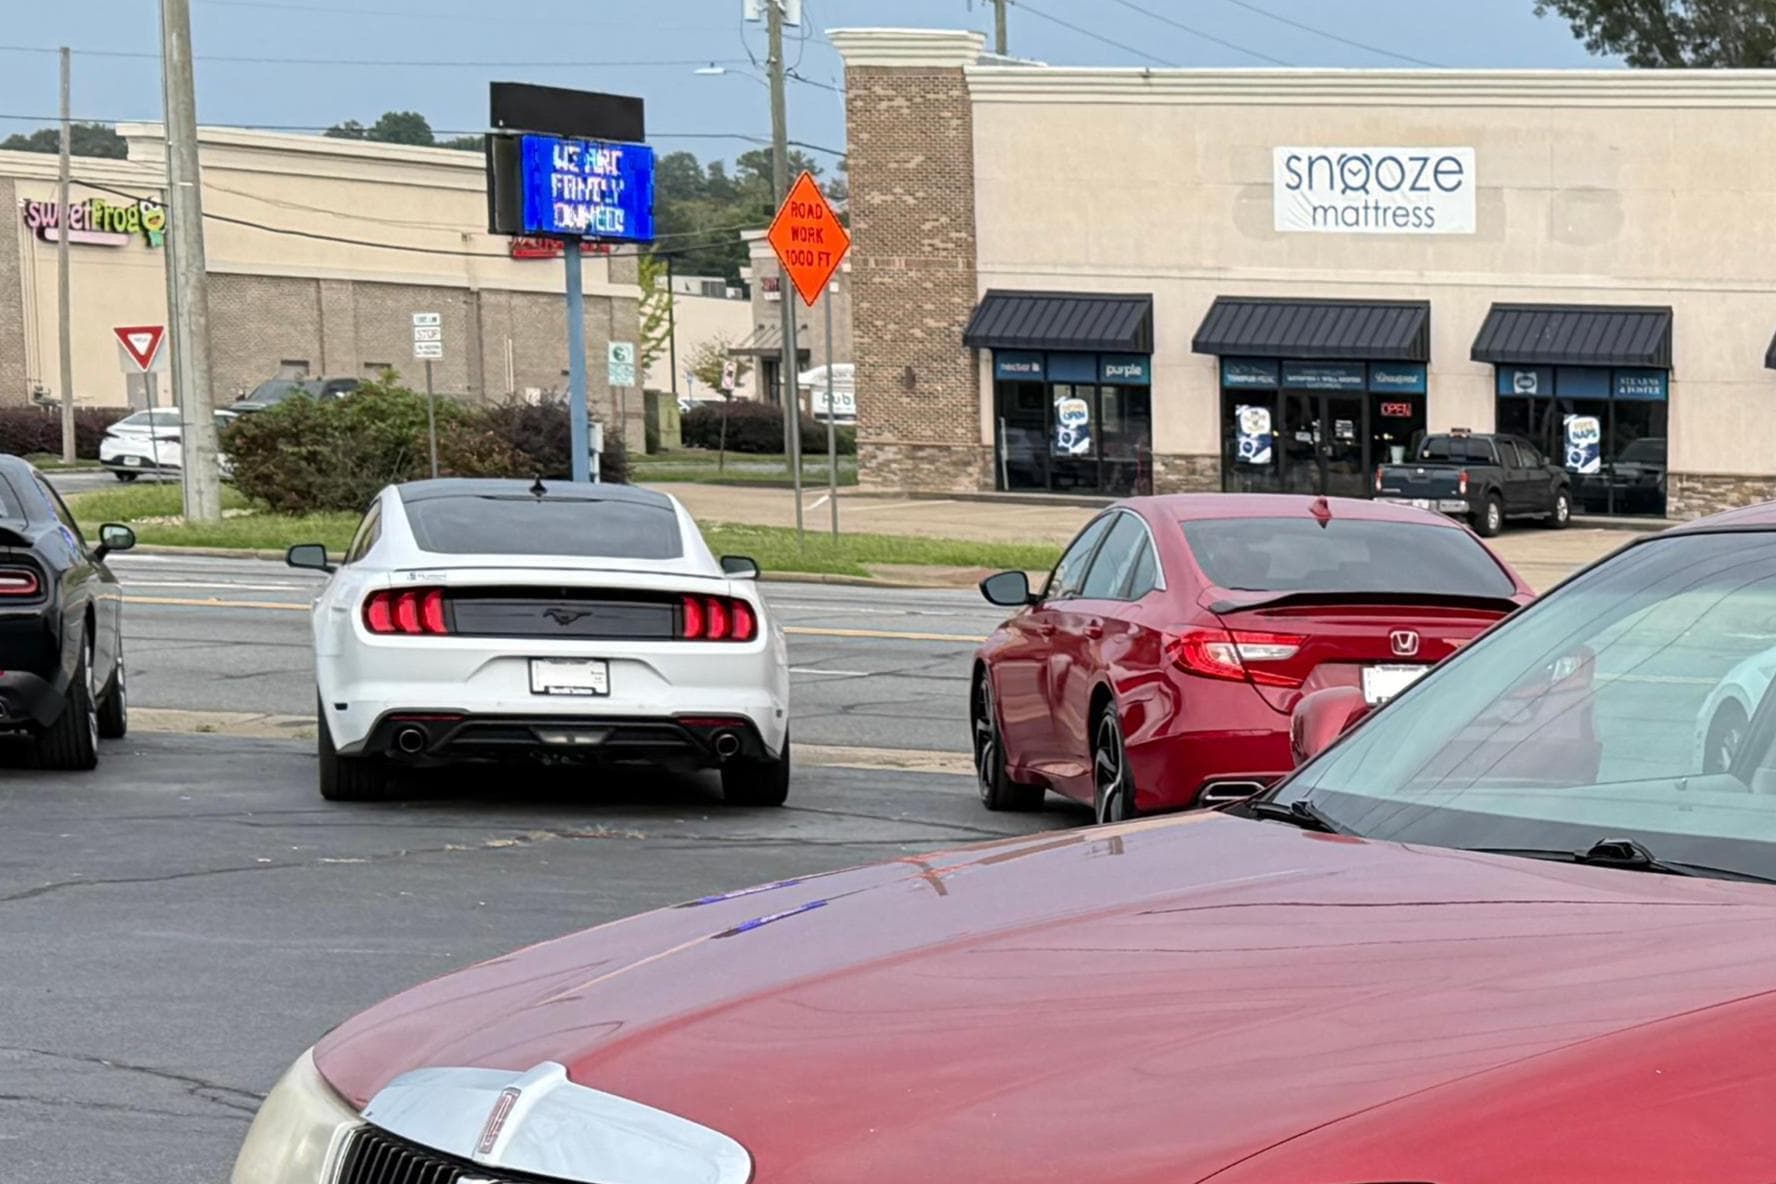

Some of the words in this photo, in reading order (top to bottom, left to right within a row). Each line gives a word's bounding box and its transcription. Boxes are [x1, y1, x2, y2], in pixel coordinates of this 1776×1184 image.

[1285, 154, 1464, 195] snooze
[26, 199, 141, 234] swetFrog
[790, 201, 823, 220] ROAD
[1312, 199, 1435, 228] mattress
[791, 226, 824, 245] WORK
[786, 249, 814, 267] 1000
[818, 251, 832, 268] FT
[1105, 363, 1142, 377] purple
[1381, 403, 1412, 416] OPEN
